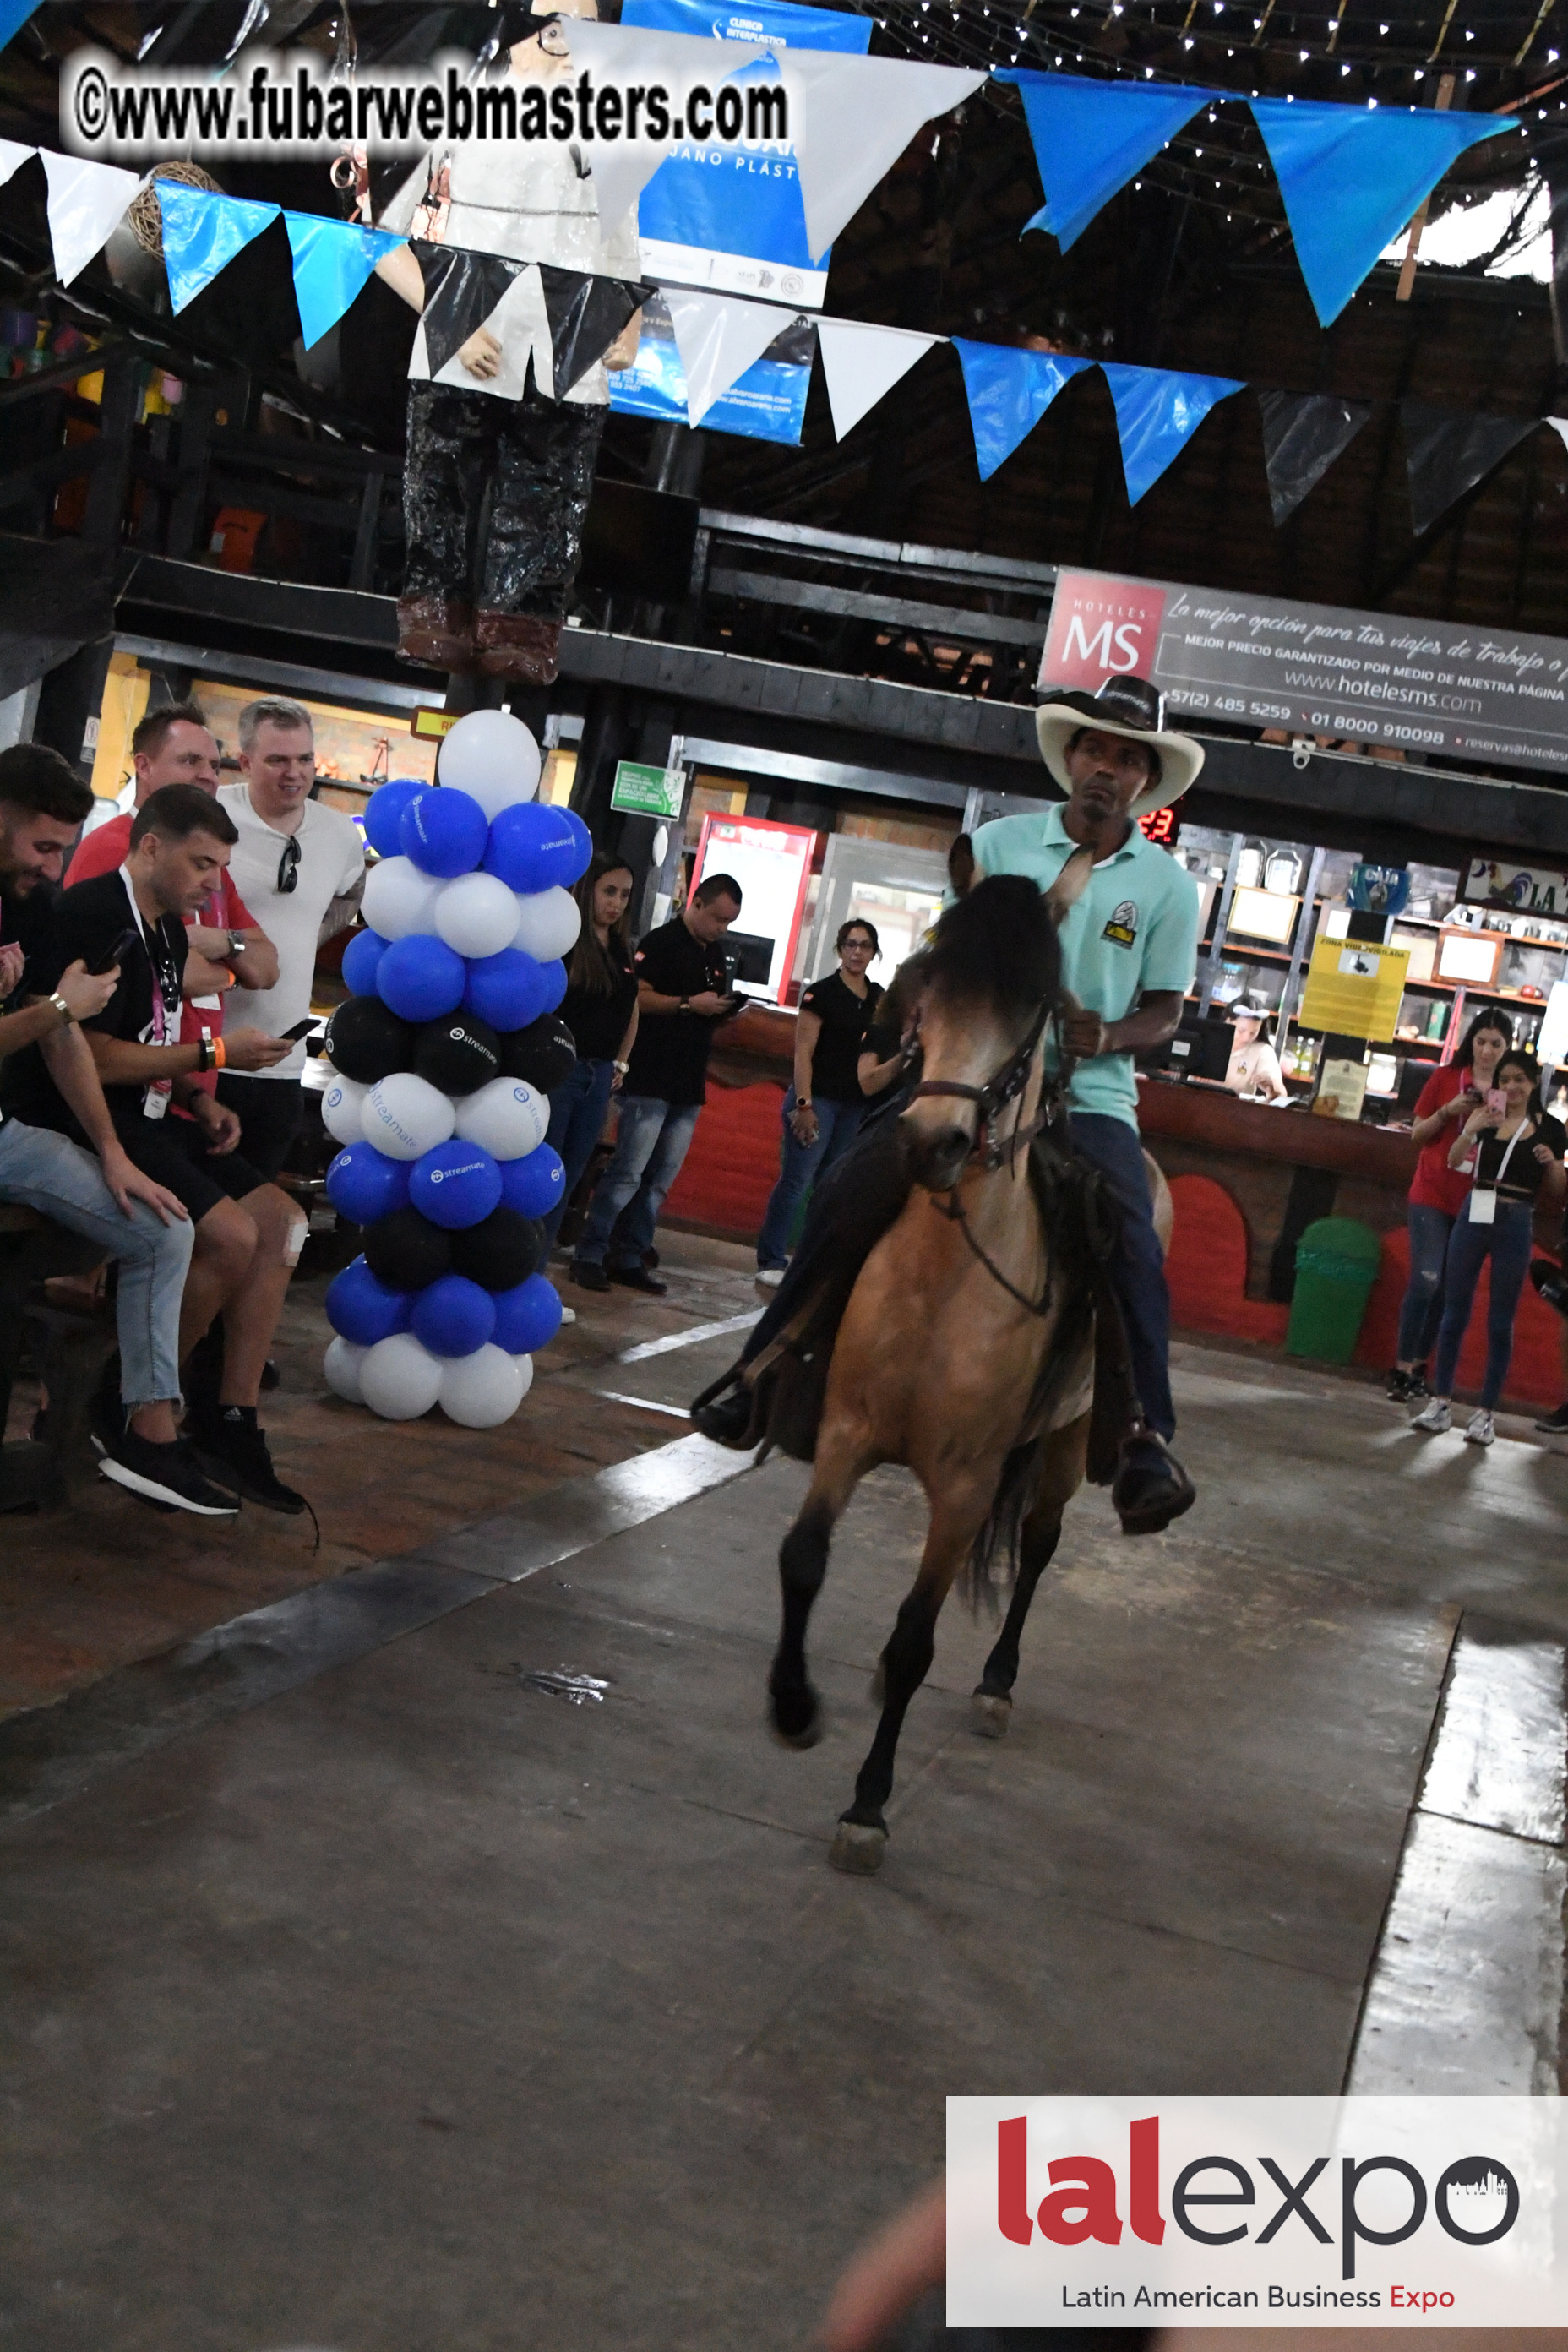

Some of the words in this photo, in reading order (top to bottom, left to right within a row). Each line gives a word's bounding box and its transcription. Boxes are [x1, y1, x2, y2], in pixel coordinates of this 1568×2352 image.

[729, 17, 764, 32] CLINICA
[1073, 599, 1146, 620] HOTELES
[1061, 615, 1142, 672] MS
[1168, 593, 1190, 618] La
[1194, 607, 1247, 631] mejor
[1249, 615, 1308, 637] opción
[1303, 624, 1353, 645] para
[1355, 623, 1385, 647] tus
[1389, 634, 1442, 661] viajes
[1446, 639, 1472, 659] de
[1475, 642, 1544, 677] trabajo
[1549, 659, 1562, 672] o
[1184, 634, 1225, 651] MEJOR
[1227, 640, 1273, 658] PRECIO
[1275, 647, 1361, 671] GARANTIZADO
[1364, 662, 1391, 676] POR
[1393, 665, 1434, 683] MEDIO
[1436, 672, 1455, 685] DE
[1457, 675, 1515, 694] NUESTRA
[1518, 682, 1565, 701] PÁGINA
[1214, 696, 1246, 713] 485
[1250, 701, 1291, 720] 5259
[1285, 670, 1483, 713] www.hotelesms.com
[1311, 711, 1331, 727] 01
[1334, 716, 1379, 735] 8000
[1383, 722, 1445, 745] 910098
[1528, 883, 1556, 913] LA
[371, 1090, 418, 1148] streamate
[444, 1162, 487, 1179] streamate
